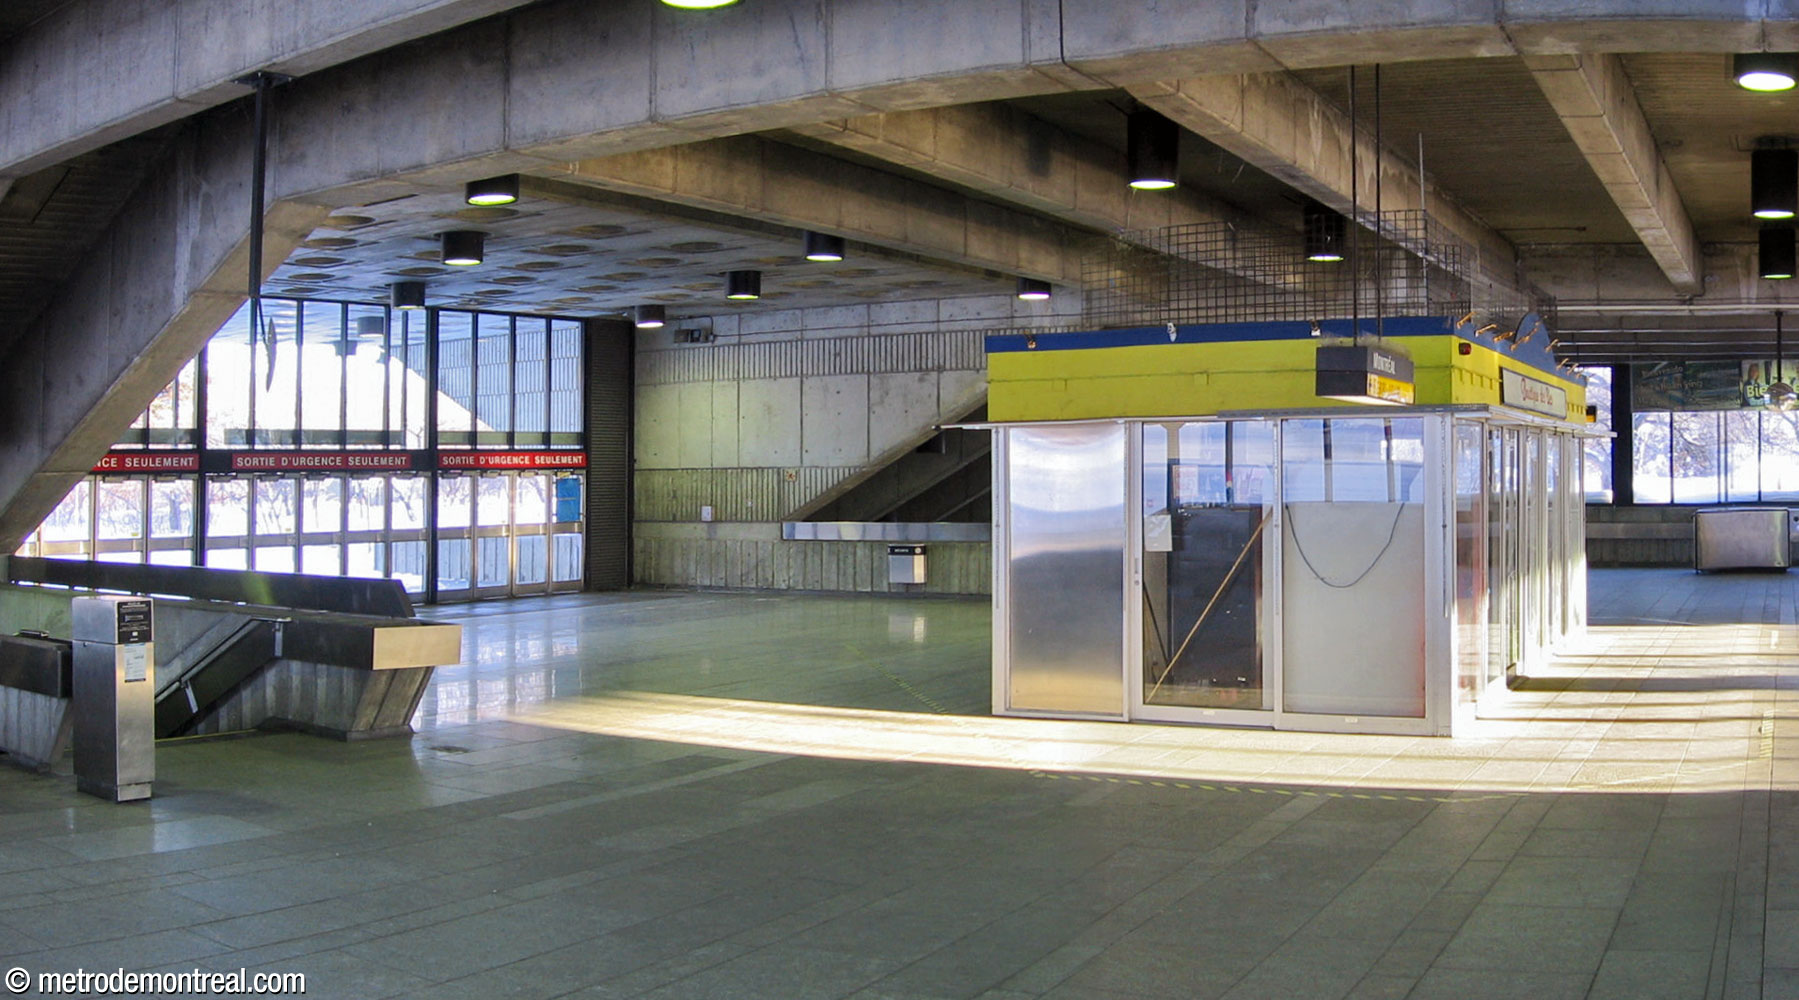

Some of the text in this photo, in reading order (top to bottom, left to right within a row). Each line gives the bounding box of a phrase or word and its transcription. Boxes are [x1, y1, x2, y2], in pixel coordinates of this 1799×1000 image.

[124, 456, 195, 468] SEULEMENT
[236, 456, 407, 467] SORTIE D'URGENCE SEULEMENT
[442, 454, 584, 465] SORTIE D'URGENCE SEULEMENT
